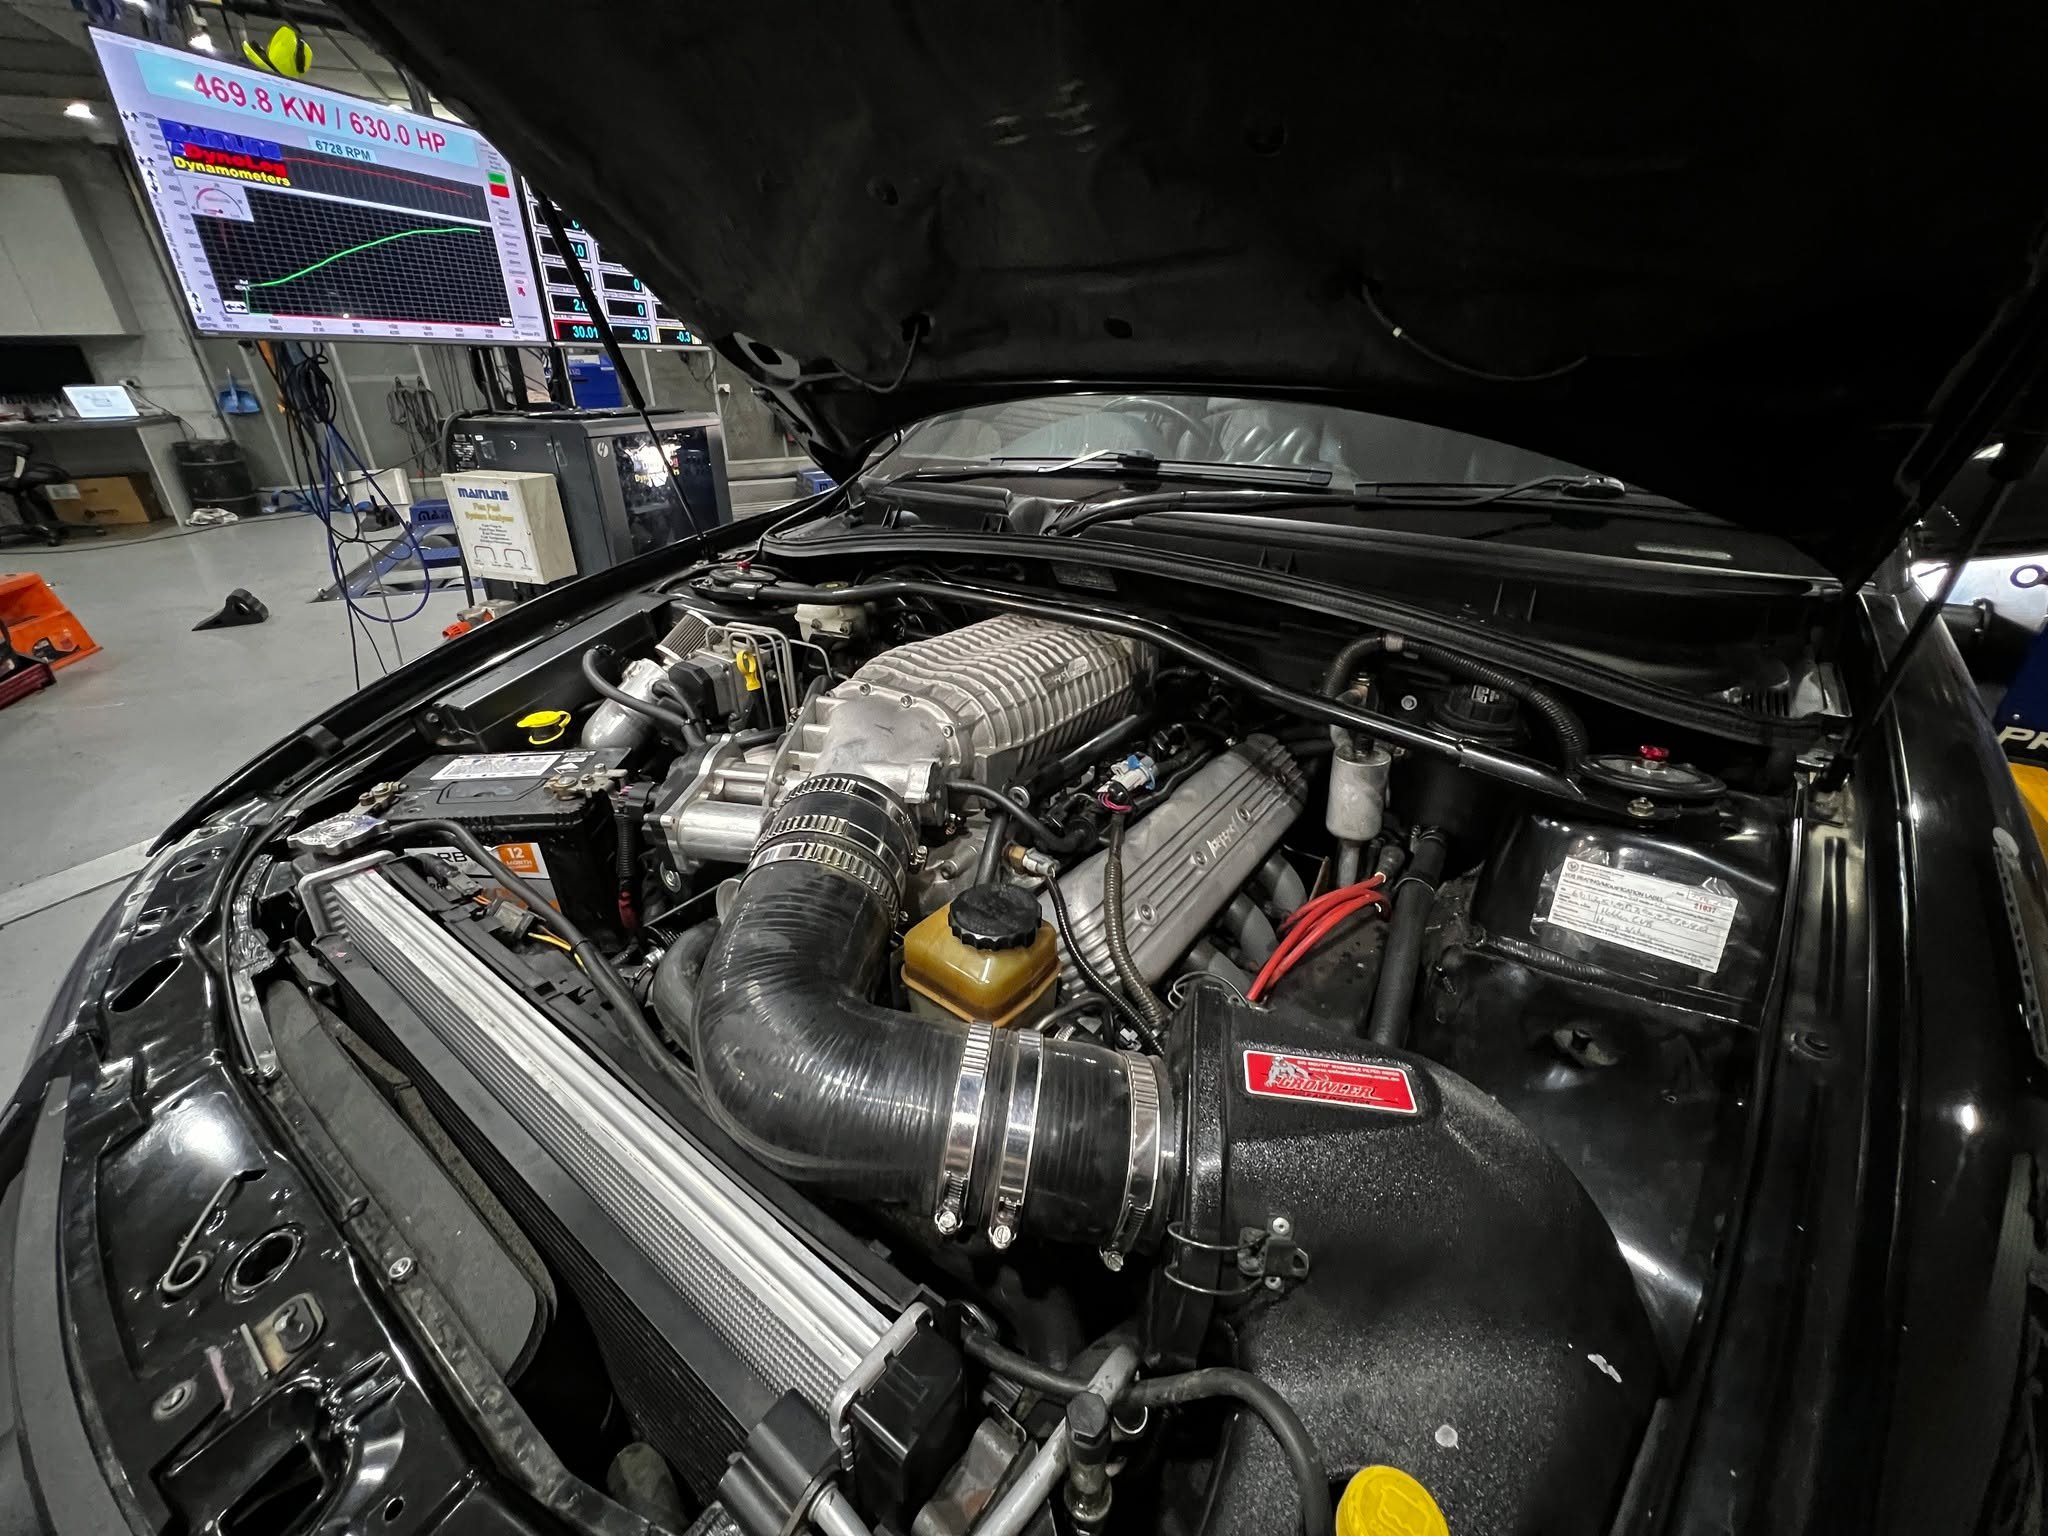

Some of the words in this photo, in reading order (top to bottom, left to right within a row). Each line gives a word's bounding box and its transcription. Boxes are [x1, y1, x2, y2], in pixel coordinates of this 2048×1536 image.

[194, 72, 273, 113] 469.8
[279, 92, 326, 126] KW
[349, 112, 411, 147] 630.0
[415, 128, 446, 153] HP
[315, 140, 343, 155] 6728
[346, 146, 372, 161] RPM
[173, 156, 291, 187] Dynamometers
[572, 325, 599, 339] 30.01
[632, 328, 649, 341] -0.3
[457, 487, 510, 501] MAINLINE
[507, 847, 525, 859] 12
